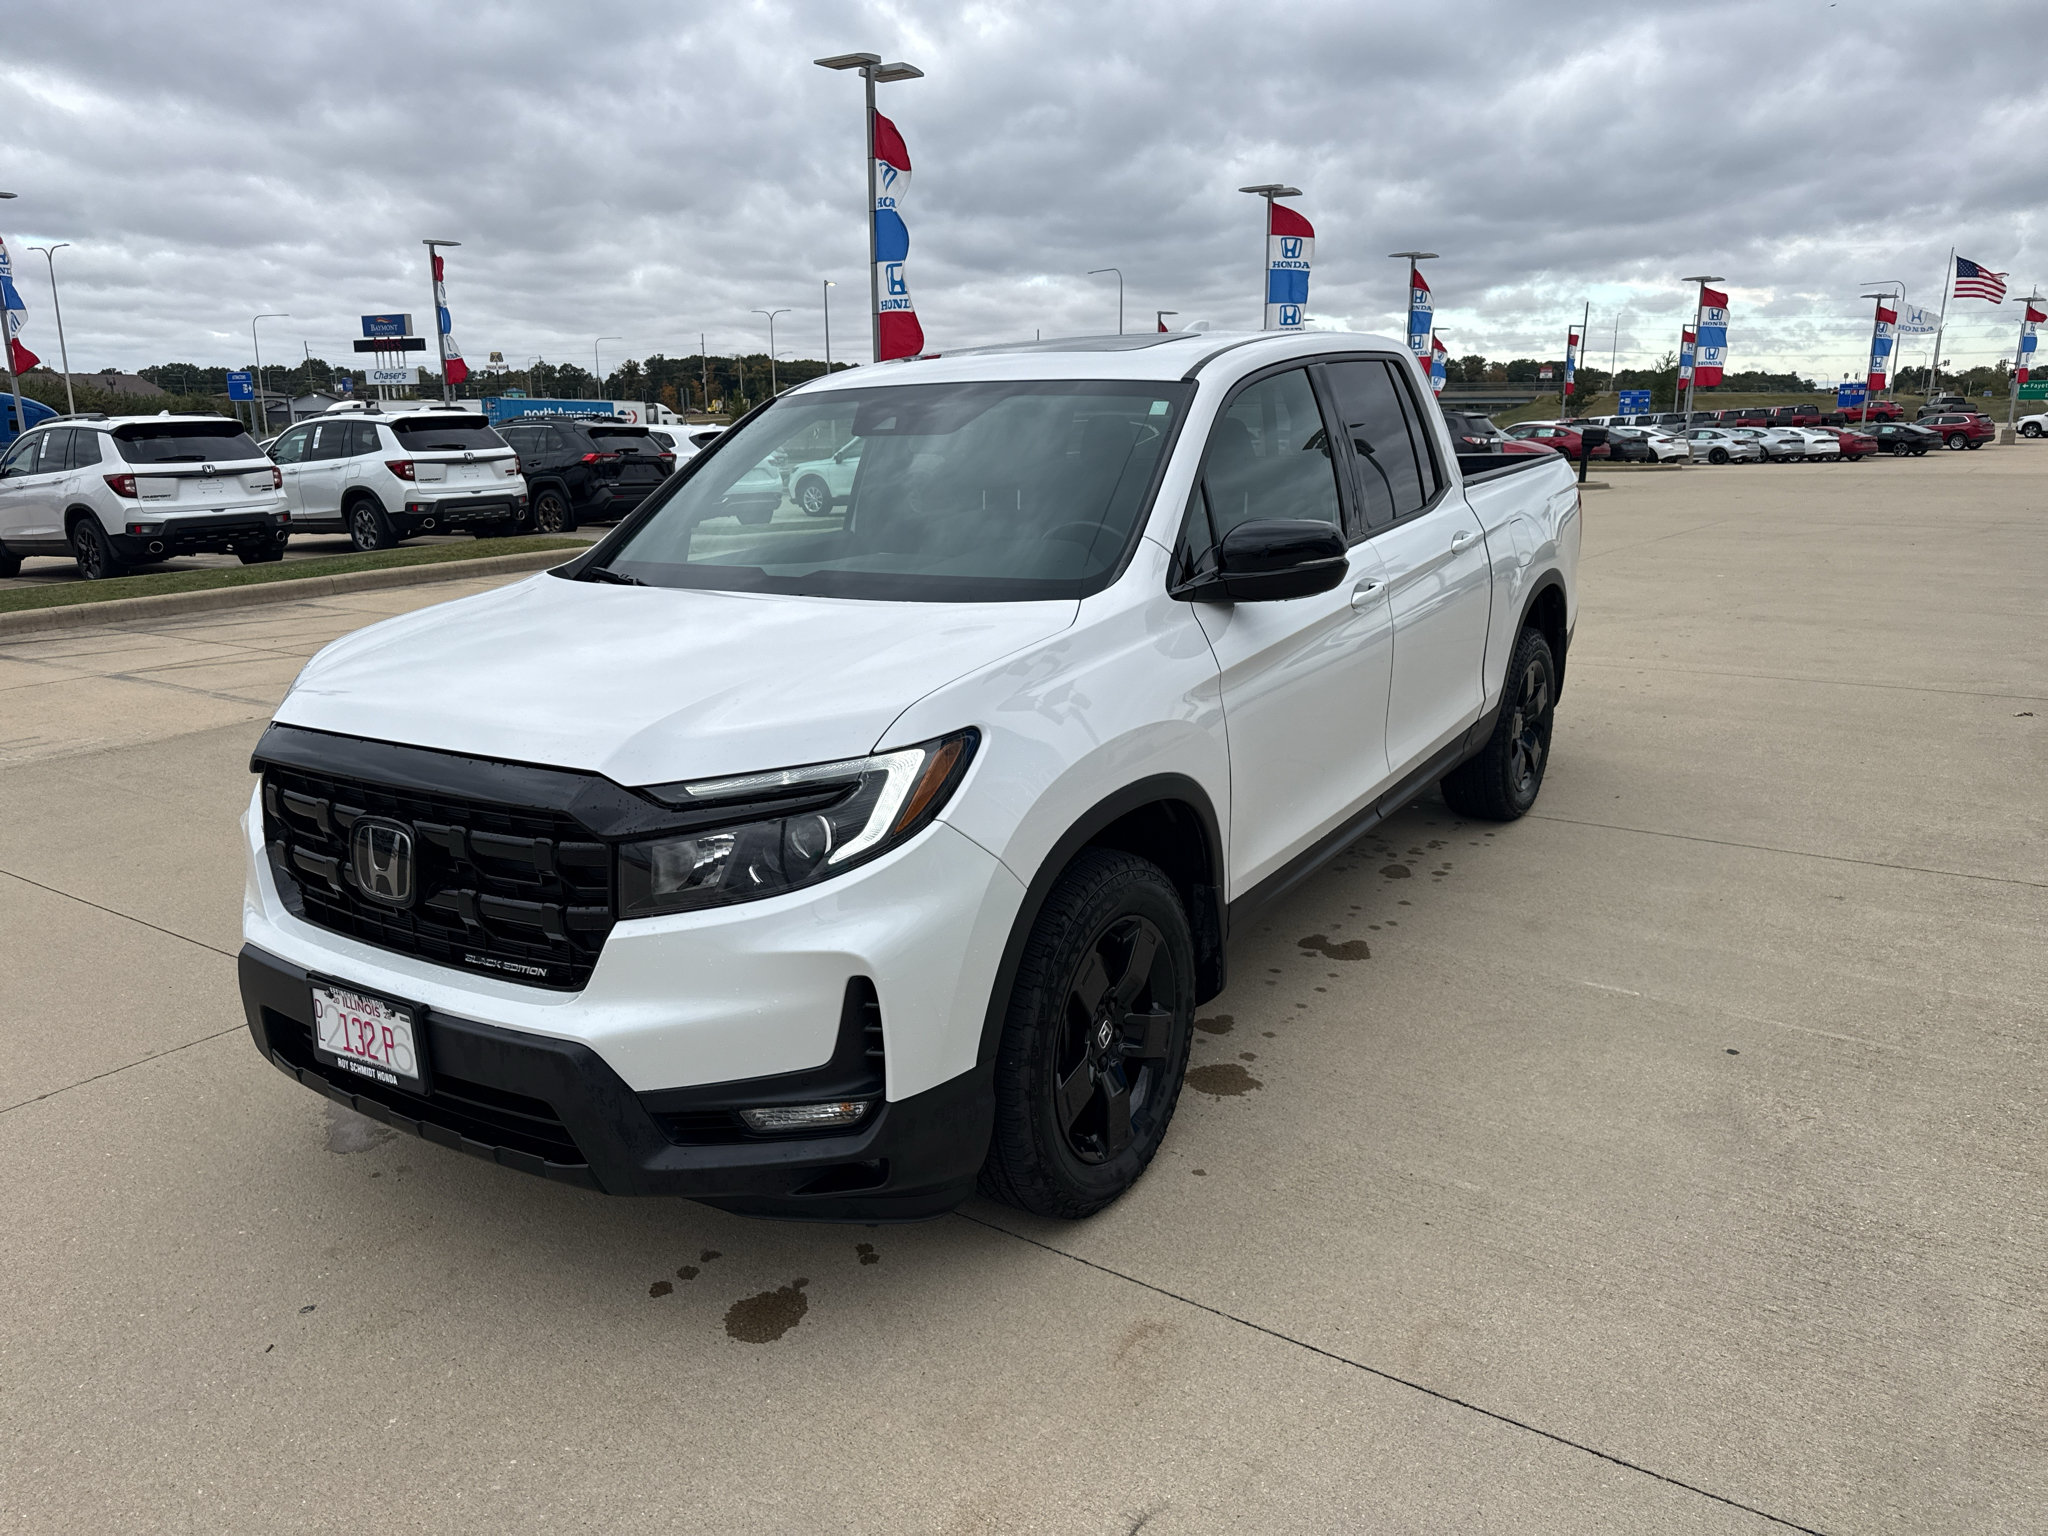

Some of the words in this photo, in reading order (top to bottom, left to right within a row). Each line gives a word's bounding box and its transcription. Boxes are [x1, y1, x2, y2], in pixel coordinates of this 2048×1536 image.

[1272, 260, 1310, 269] HONDA
[370, 324, 398, 332] BAYMONT
[1897, 324, 1934, 333] HONDA
[373, 370, 407, 380] Chaser's
[465, 953, 501, 968] BLACK
[503, 961, 548, 977] EDITION
[341, 995, 381, 1018] ILLINOIS
[339, 1012, 379, 1061] 132
[337, 1056, 349, 1070] ROY
[349, 1062, 376, 1079] SCHMIDT
[377, 1069, 398, 1086] HONDA
